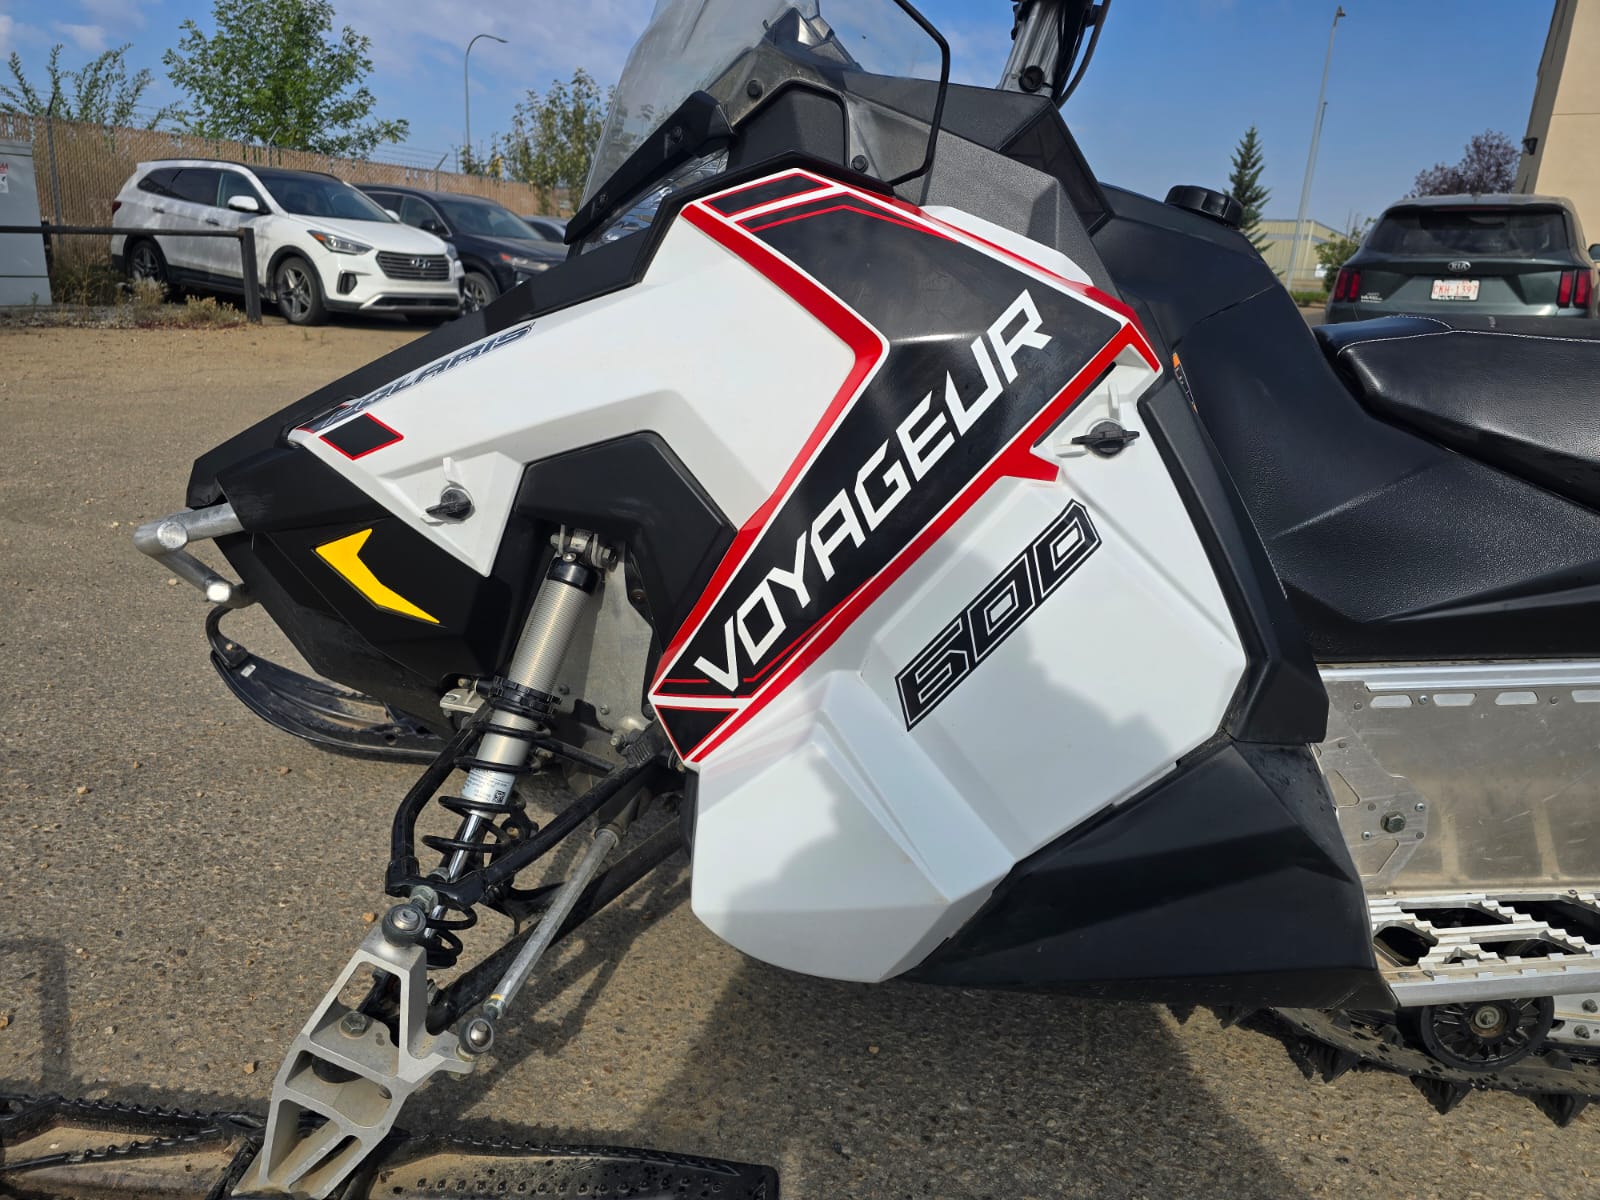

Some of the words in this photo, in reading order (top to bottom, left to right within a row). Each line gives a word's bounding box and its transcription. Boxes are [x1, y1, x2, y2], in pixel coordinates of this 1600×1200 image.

[1450, 262, 1468, 270] KIA
[320, 321, 536, 428] POLARIS
[694, 289, 1052, 691] VOYAGEUR
[895, 499, 1102, 731] 600
